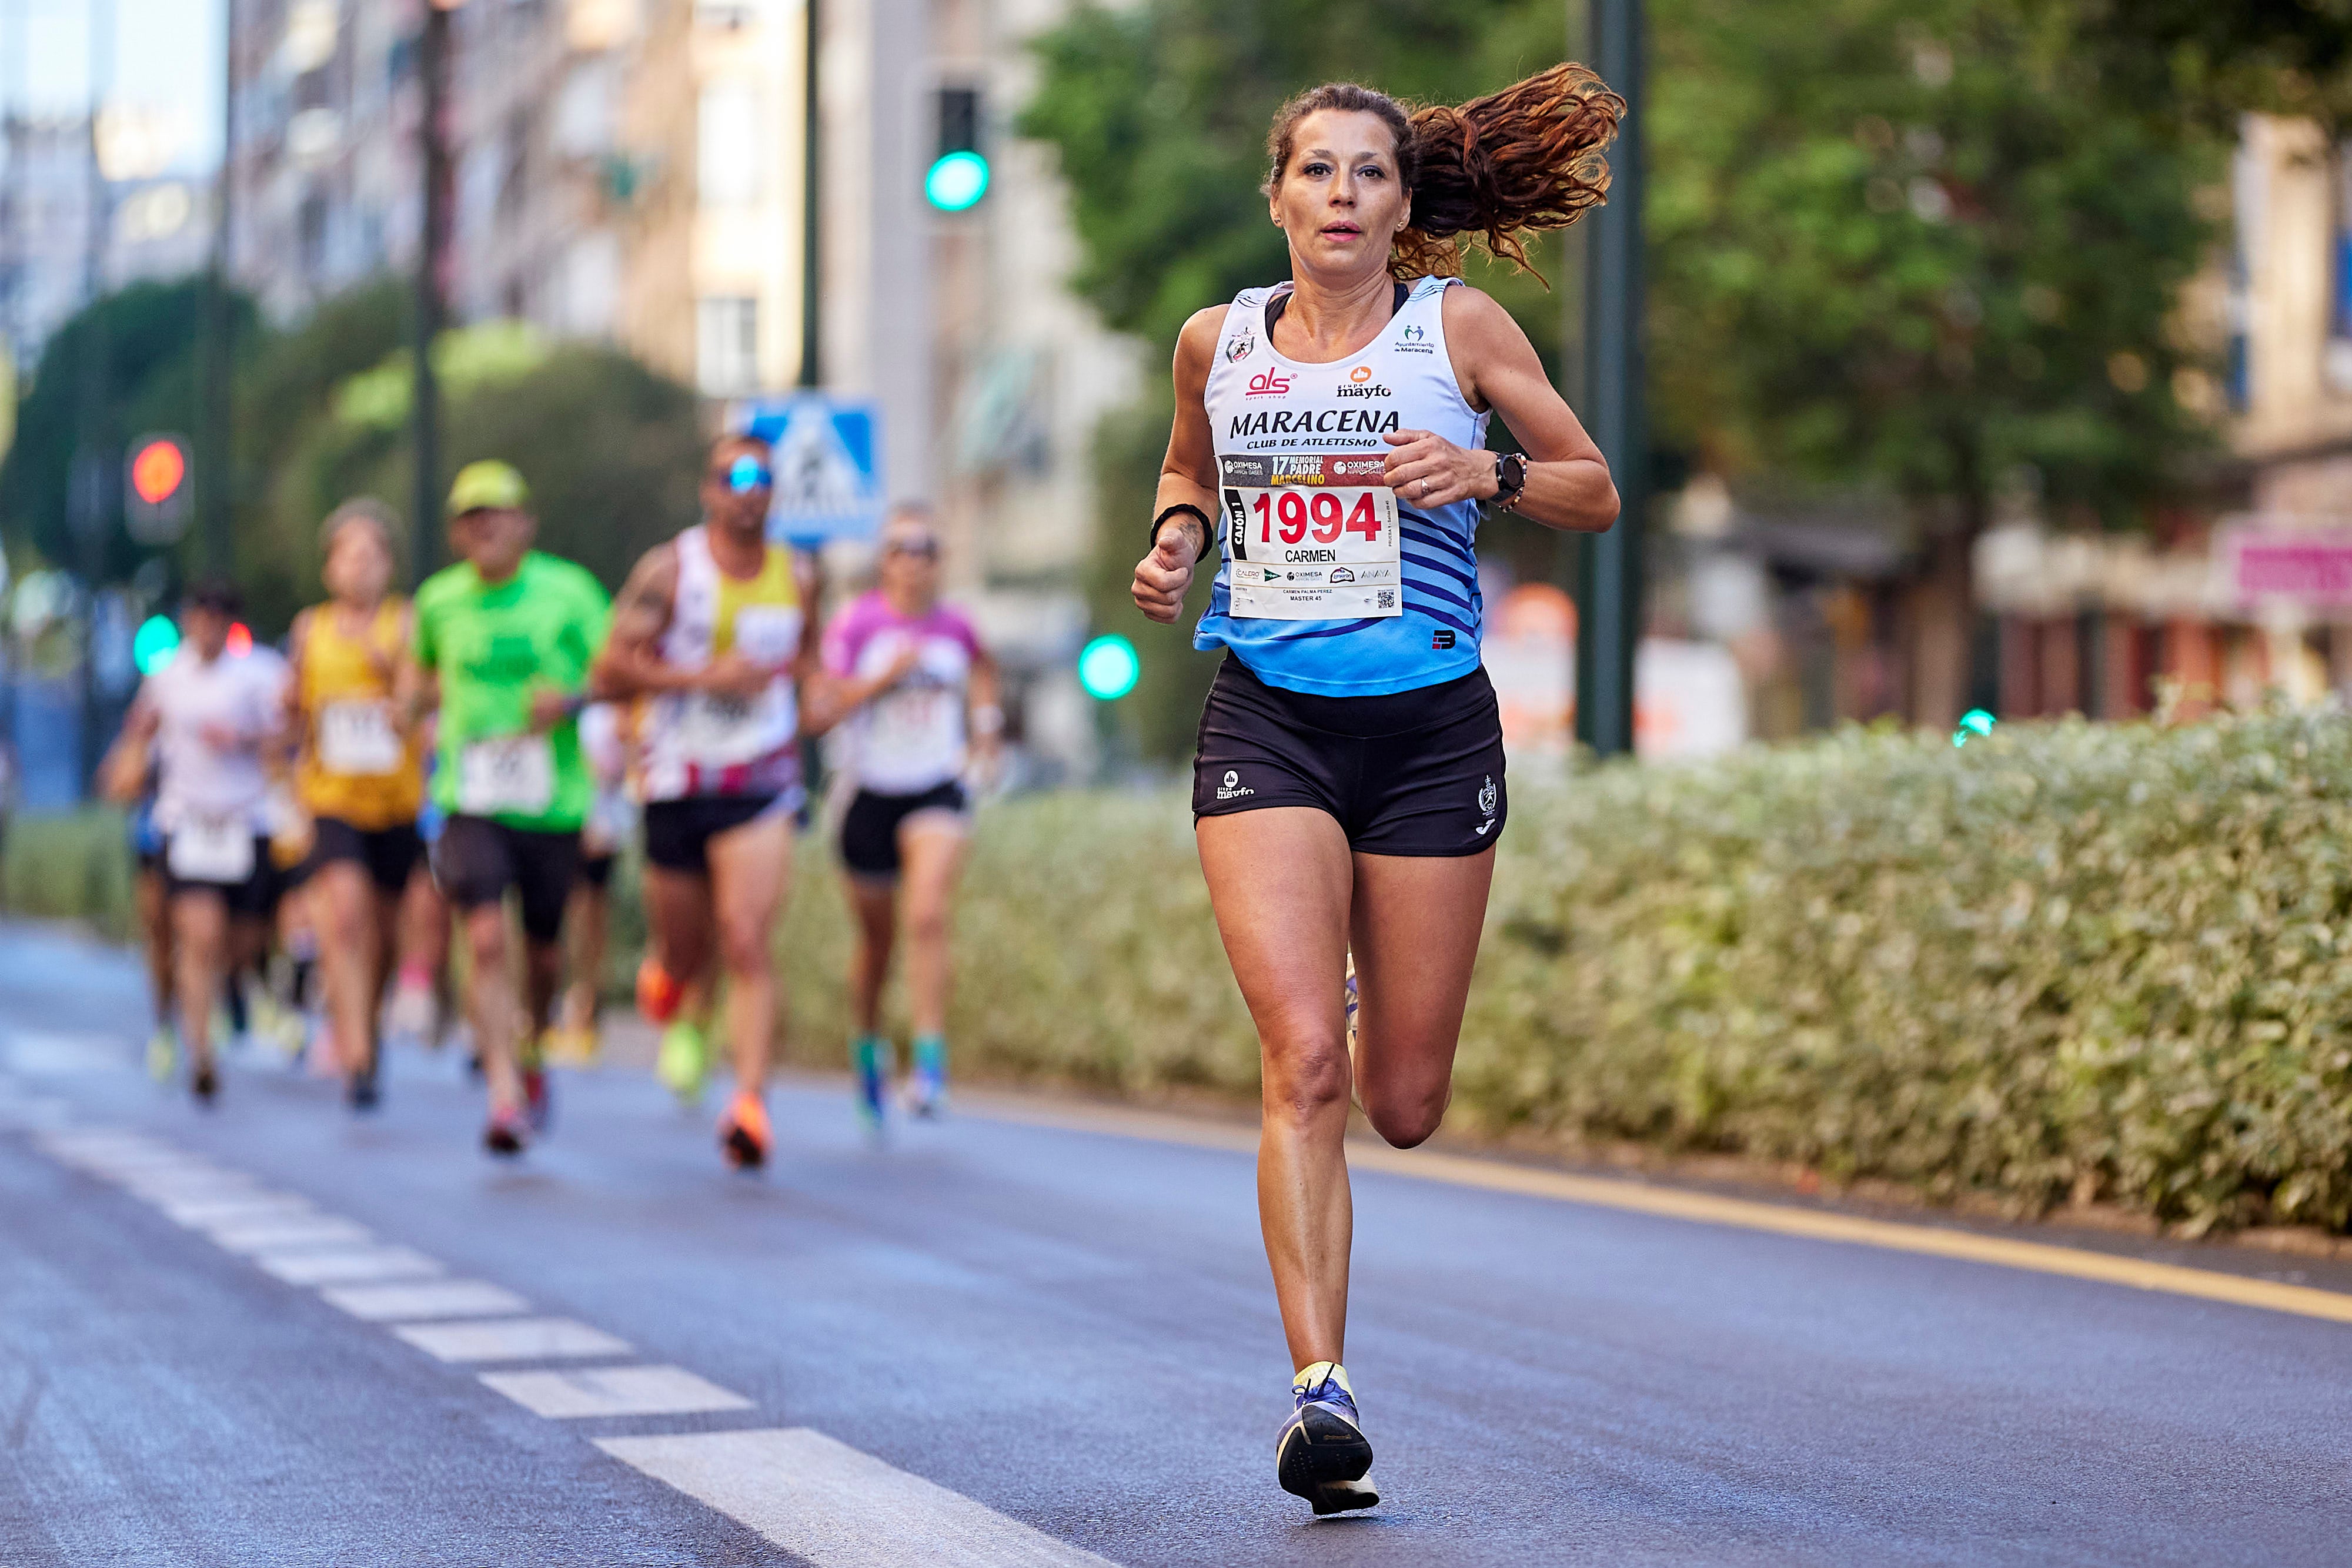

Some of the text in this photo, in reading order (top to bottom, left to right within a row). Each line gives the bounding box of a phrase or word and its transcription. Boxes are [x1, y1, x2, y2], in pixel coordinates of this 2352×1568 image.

[1337, 385, 1391, 399] mayfo
[1230, 410, 1399, 439] MARACENA
[1247, 438, 1377, 449] CLUB DE ATLETISMO
[1234, 461, 1262, 469] OXIMESA
[1272, 456, 1324, 475] 17 MEMORIAL
[1291, 464, 1321, 474] PADRE
[1271, 474, 1325, 486] MARCELINO
[1253, 492, 1382, 544] 1994
[1234, 510, 1245, 545] CAJÓN
[1285, 549, 1336, 563] CARMEN
[1361, 570, 1392, 579] ANAYA
